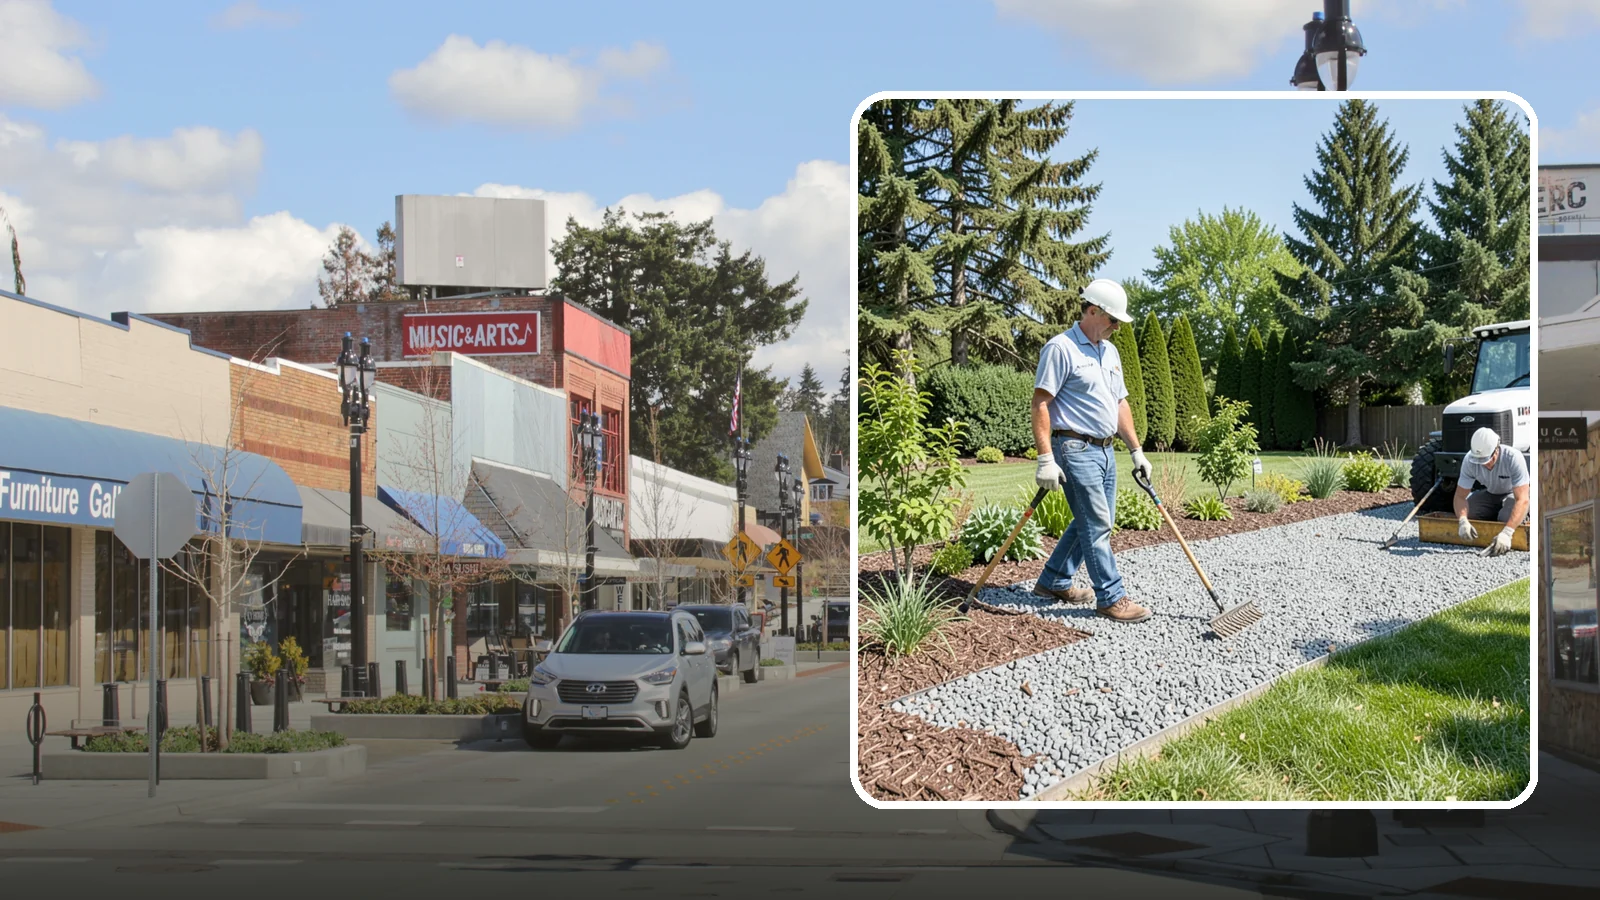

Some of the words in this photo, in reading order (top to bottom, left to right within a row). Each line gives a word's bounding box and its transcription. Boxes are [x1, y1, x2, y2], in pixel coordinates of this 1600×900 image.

[409, 323, 519, 348] MUSIC&ARTS
[0, 471, 79, 515] Furniture
[89, 482, 122, 519] Gal
[453, 563, 479, 574] SUSHI
